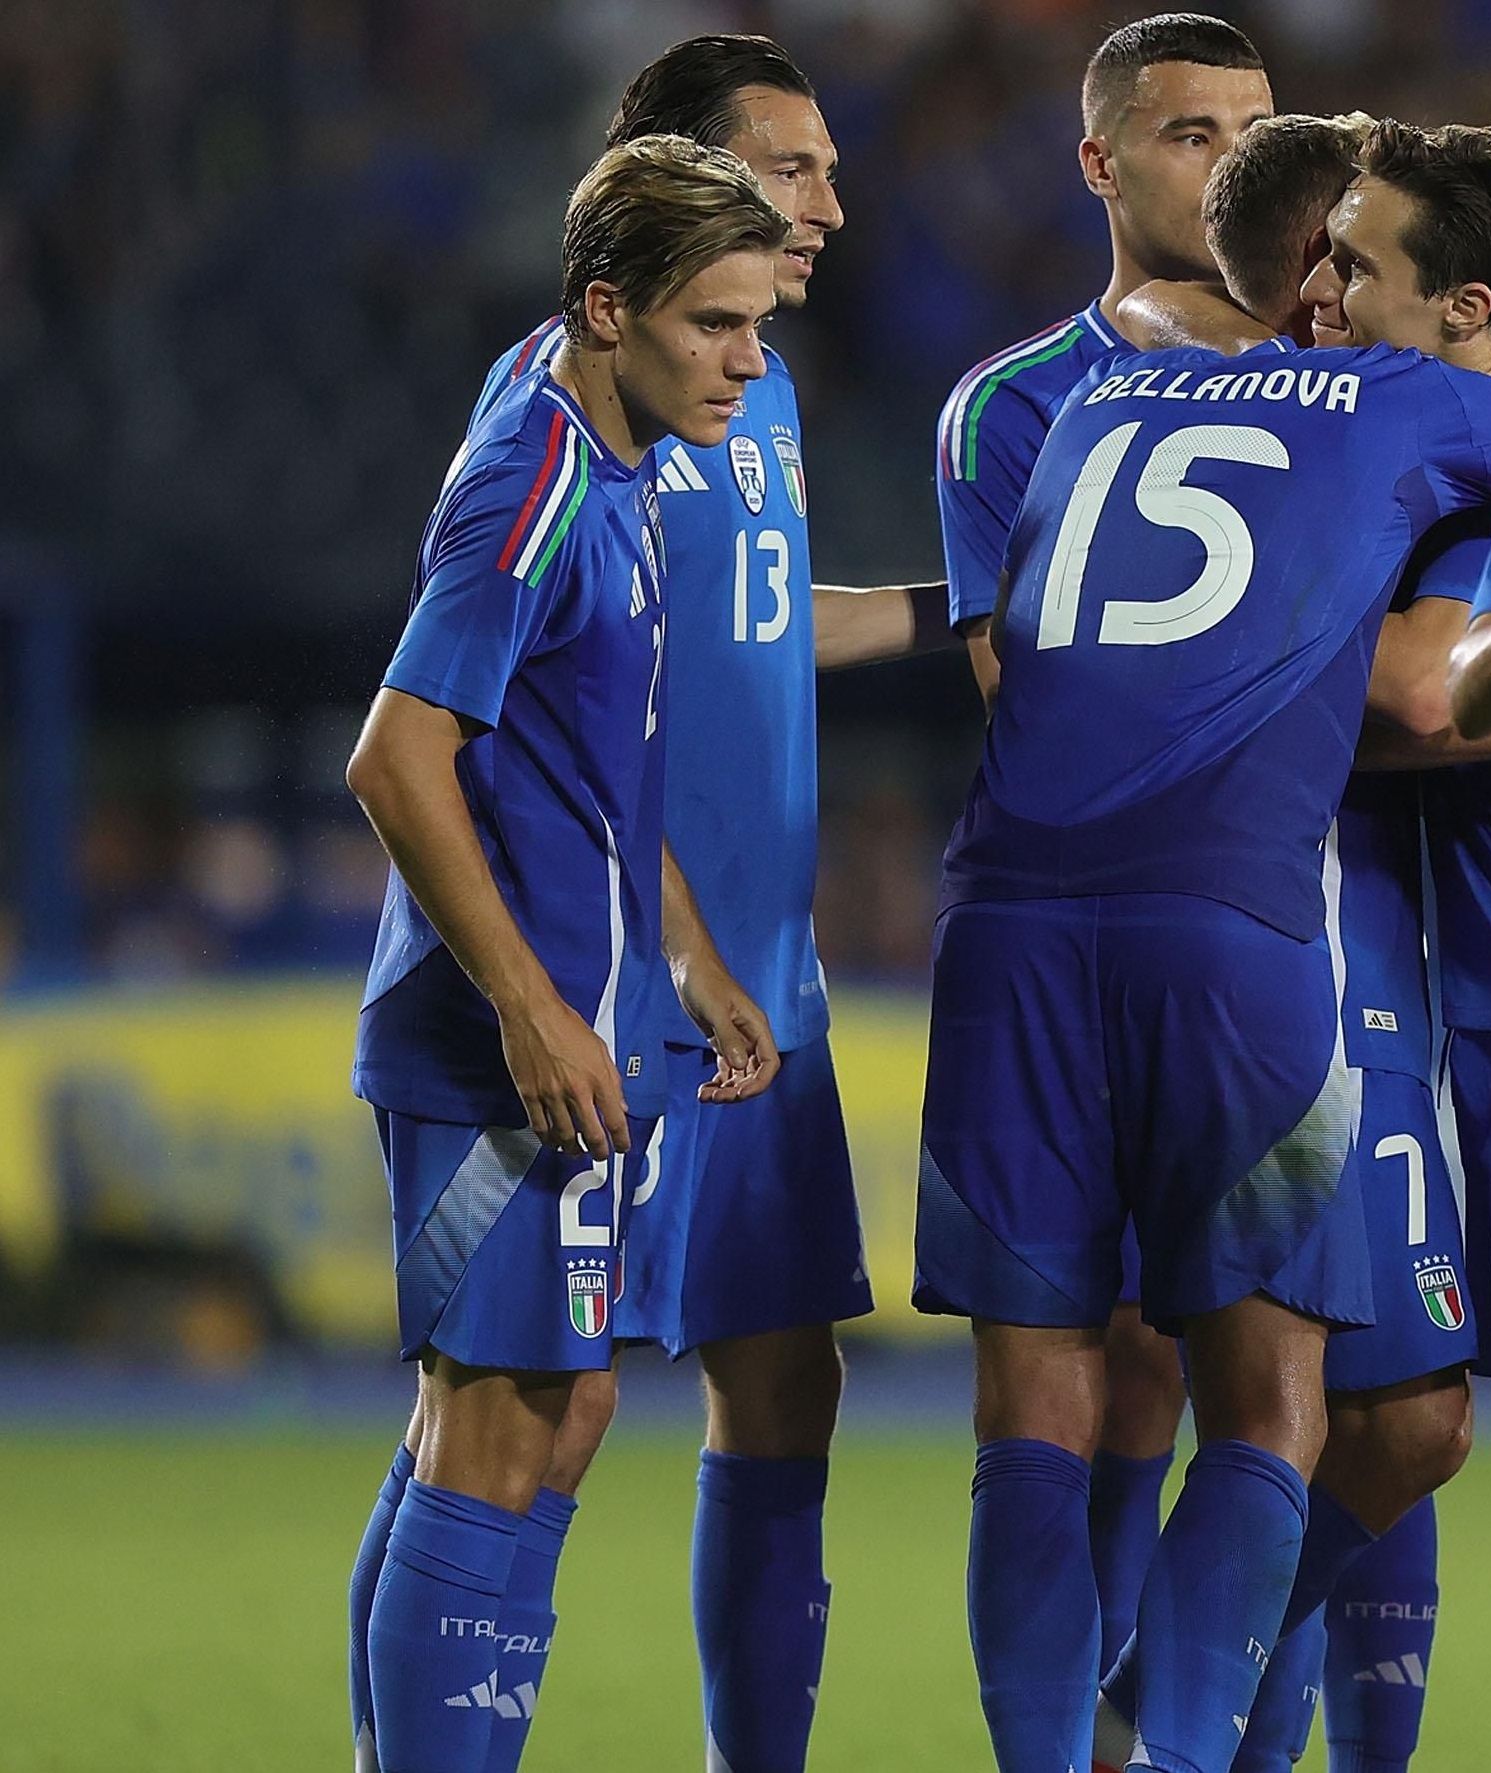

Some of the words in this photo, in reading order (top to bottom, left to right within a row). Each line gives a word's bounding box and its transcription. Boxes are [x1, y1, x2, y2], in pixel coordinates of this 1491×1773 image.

[1083, 369, 1361, 414] BELLANOVA
[734, 529, 790, 643] 13
[1036, 420, 1290, 651] 15
[644, 612, 666, 741] 2
[1375, 1133, 1427, 1246] 7
[571, 1276, 604, 1290] ITALIA
[1420, 1270, 1454, 1289] ITALIA
